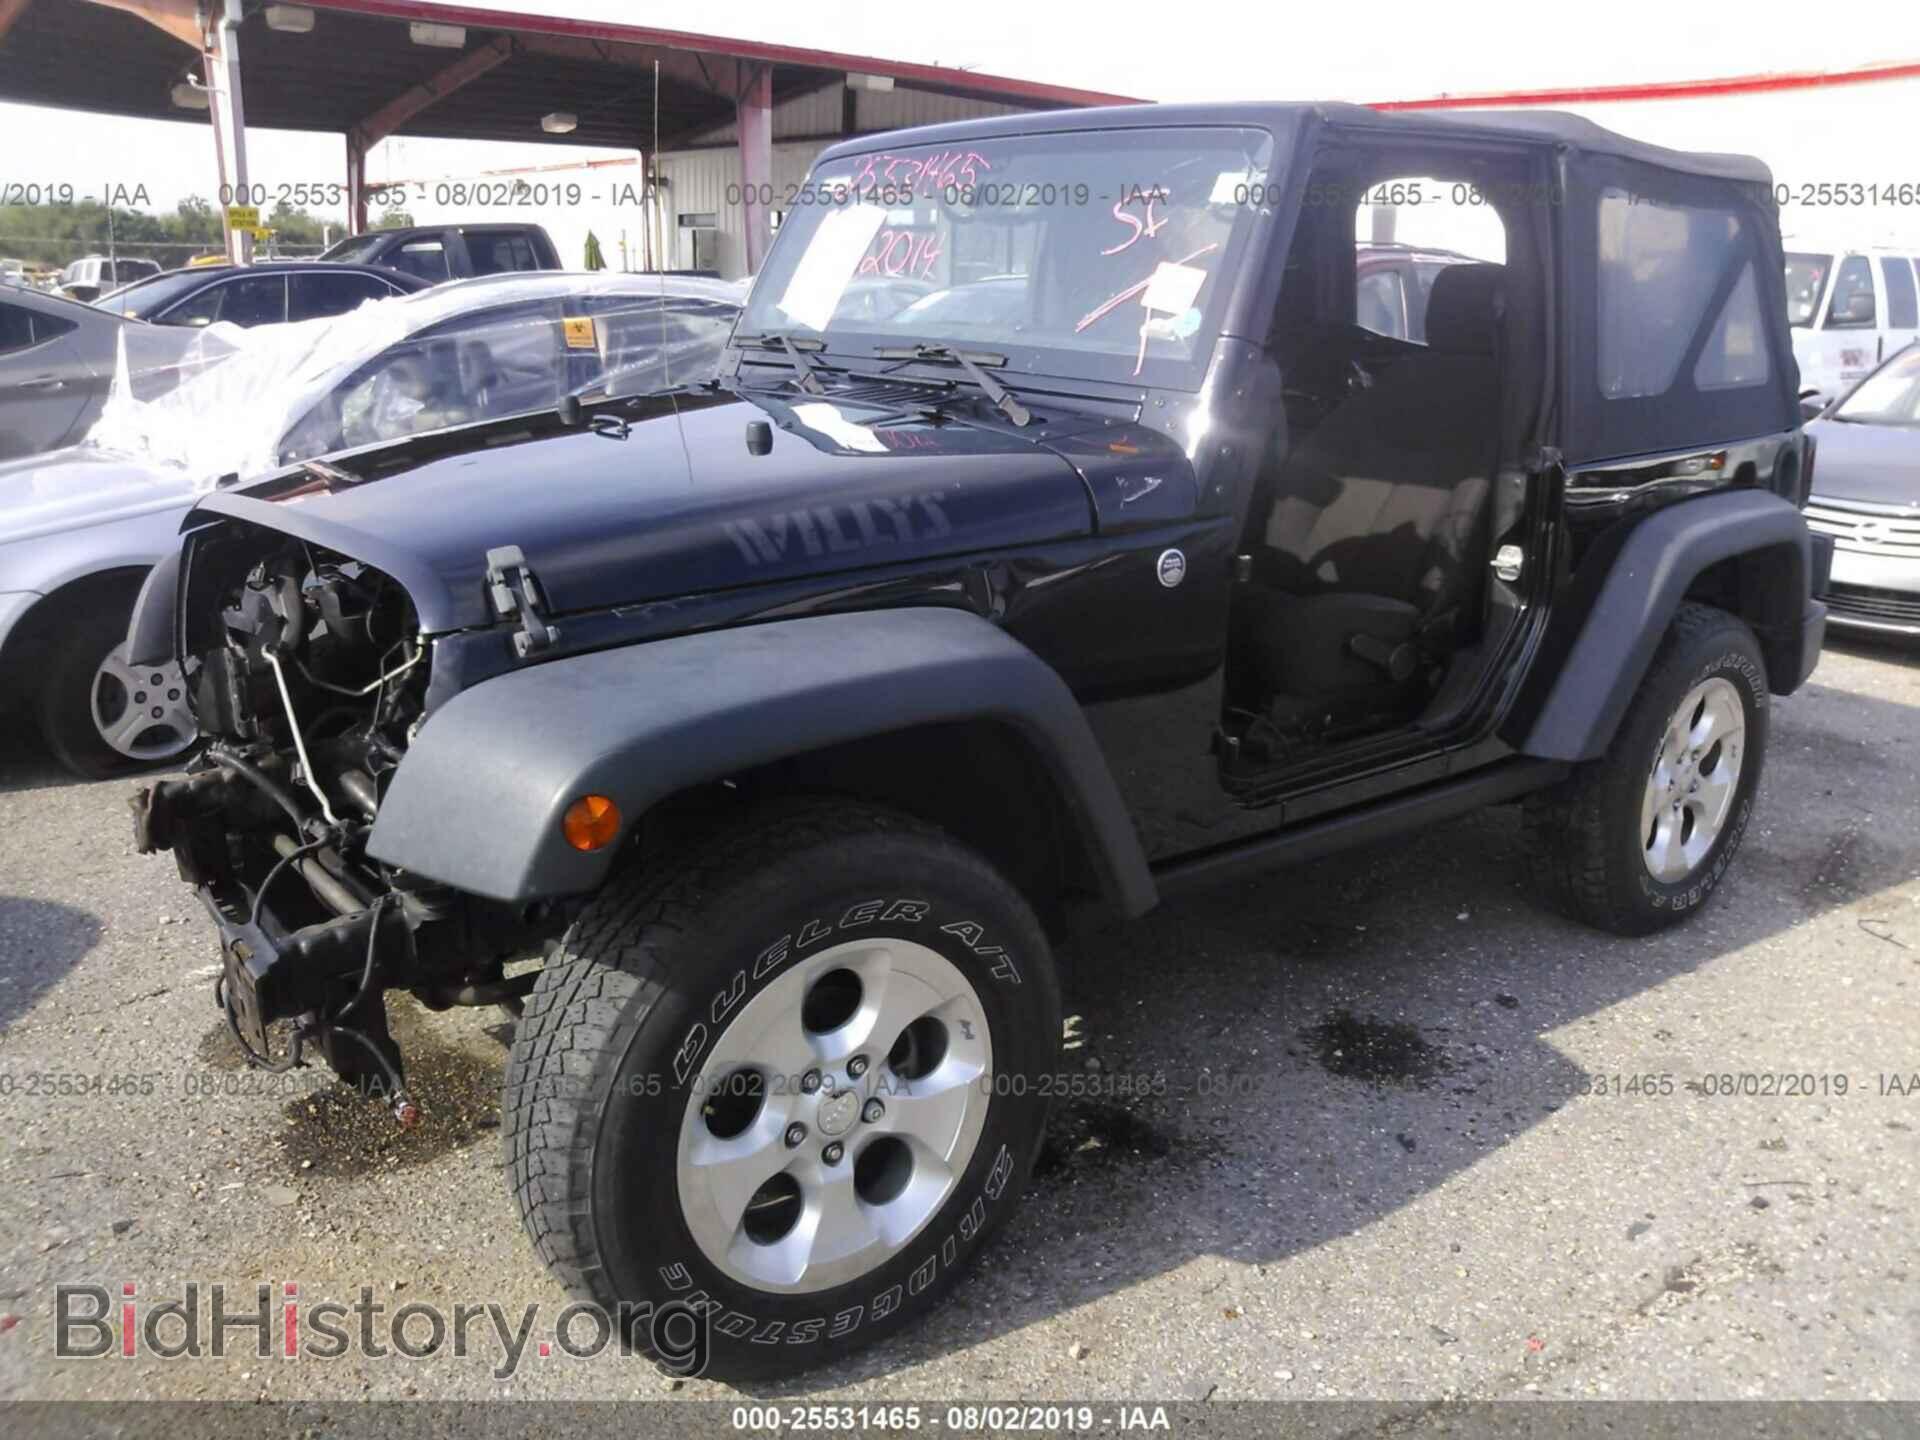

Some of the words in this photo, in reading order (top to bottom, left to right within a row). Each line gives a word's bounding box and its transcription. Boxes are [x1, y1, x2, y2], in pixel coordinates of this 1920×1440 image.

[857, 229, 946, 280] 2014
[718, 491, 951, 567] WILLYS
[672, 899, 930, 1085] DUELER
[659, 1144, 1014, 1345] BRIDGESTONE
